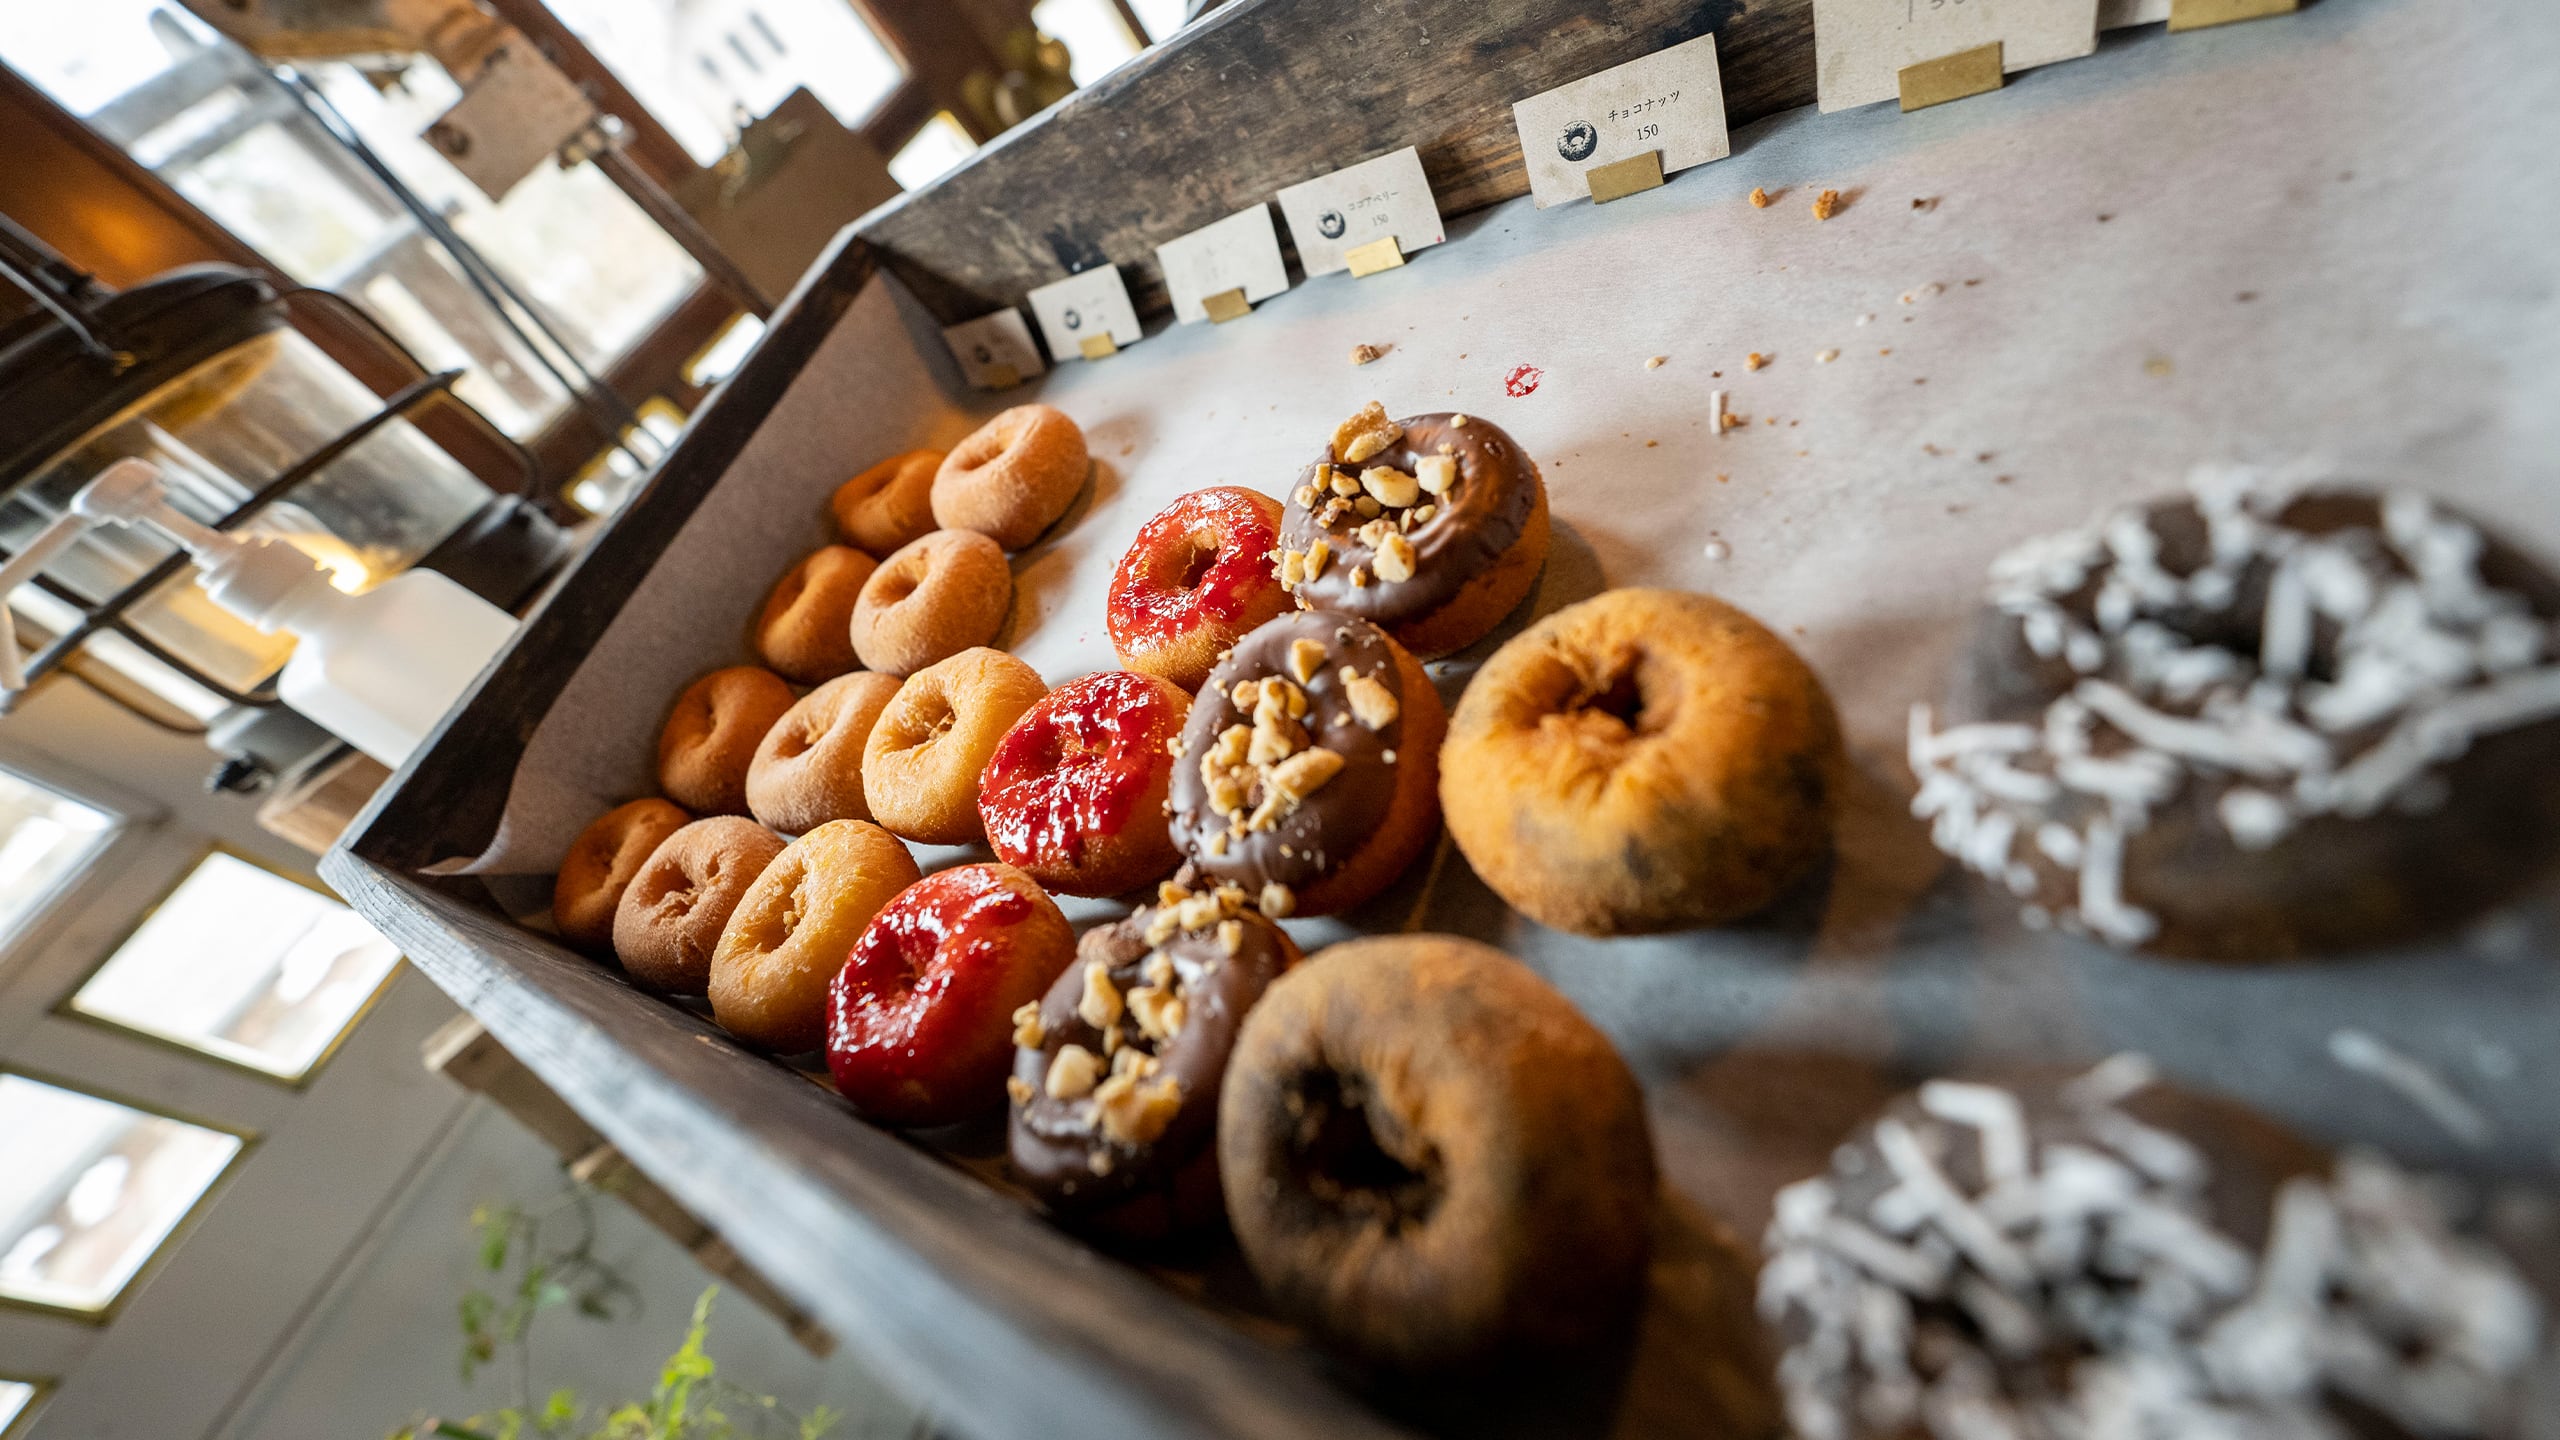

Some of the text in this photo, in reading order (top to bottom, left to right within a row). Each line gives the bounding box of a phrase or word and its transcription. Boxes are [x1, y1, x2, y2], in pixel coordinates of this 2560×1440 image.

[1608, 90, 1680, 122] チョコナッツ
[1637, 123, 1659, 140] 150
[1372, 213, 1389, 227] 150
